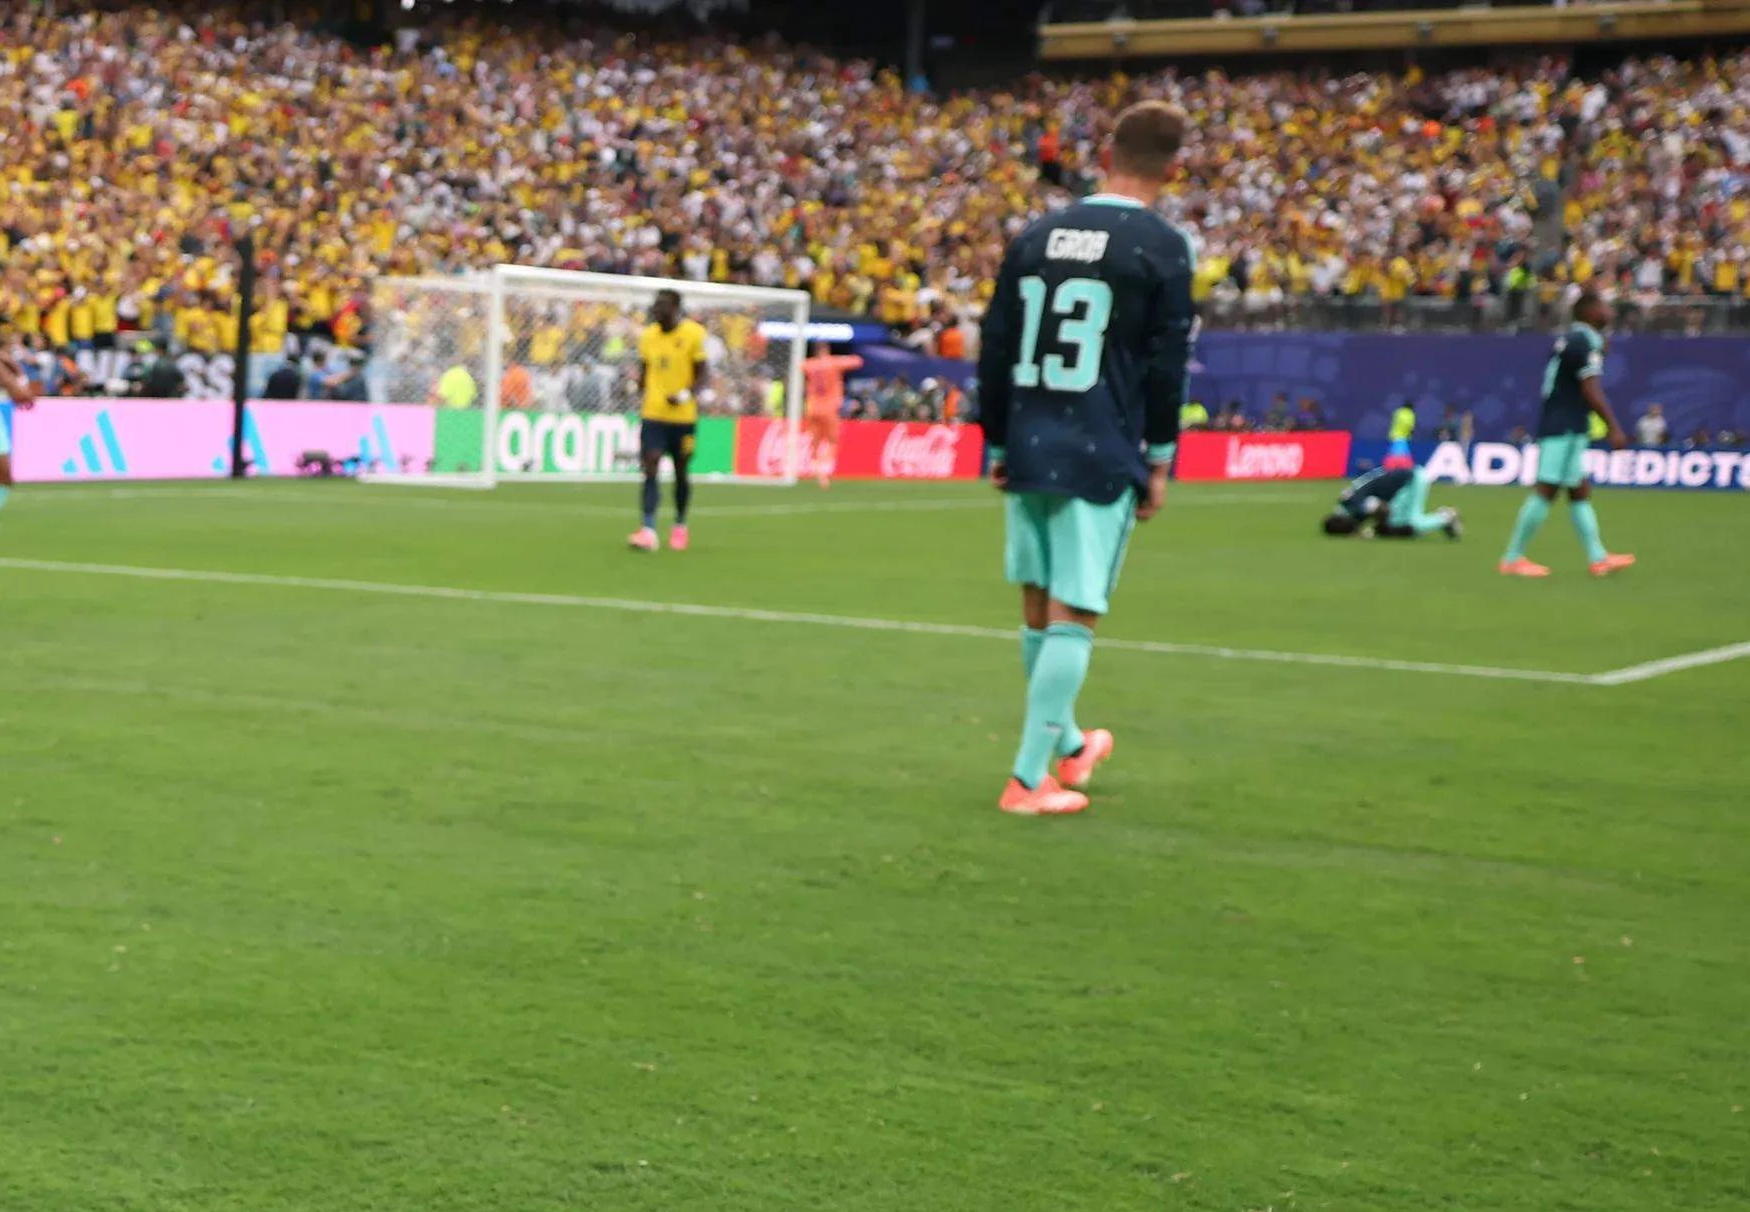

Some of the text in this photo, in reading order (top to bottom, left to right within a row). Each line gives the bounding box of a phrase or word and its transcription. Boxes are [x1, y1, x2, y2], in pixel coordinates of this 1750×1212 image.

[1012, 275, 1113, 392] 13
[500, 412, 644, 473] aram
[1580, 449, 1750, 488] REDICT
